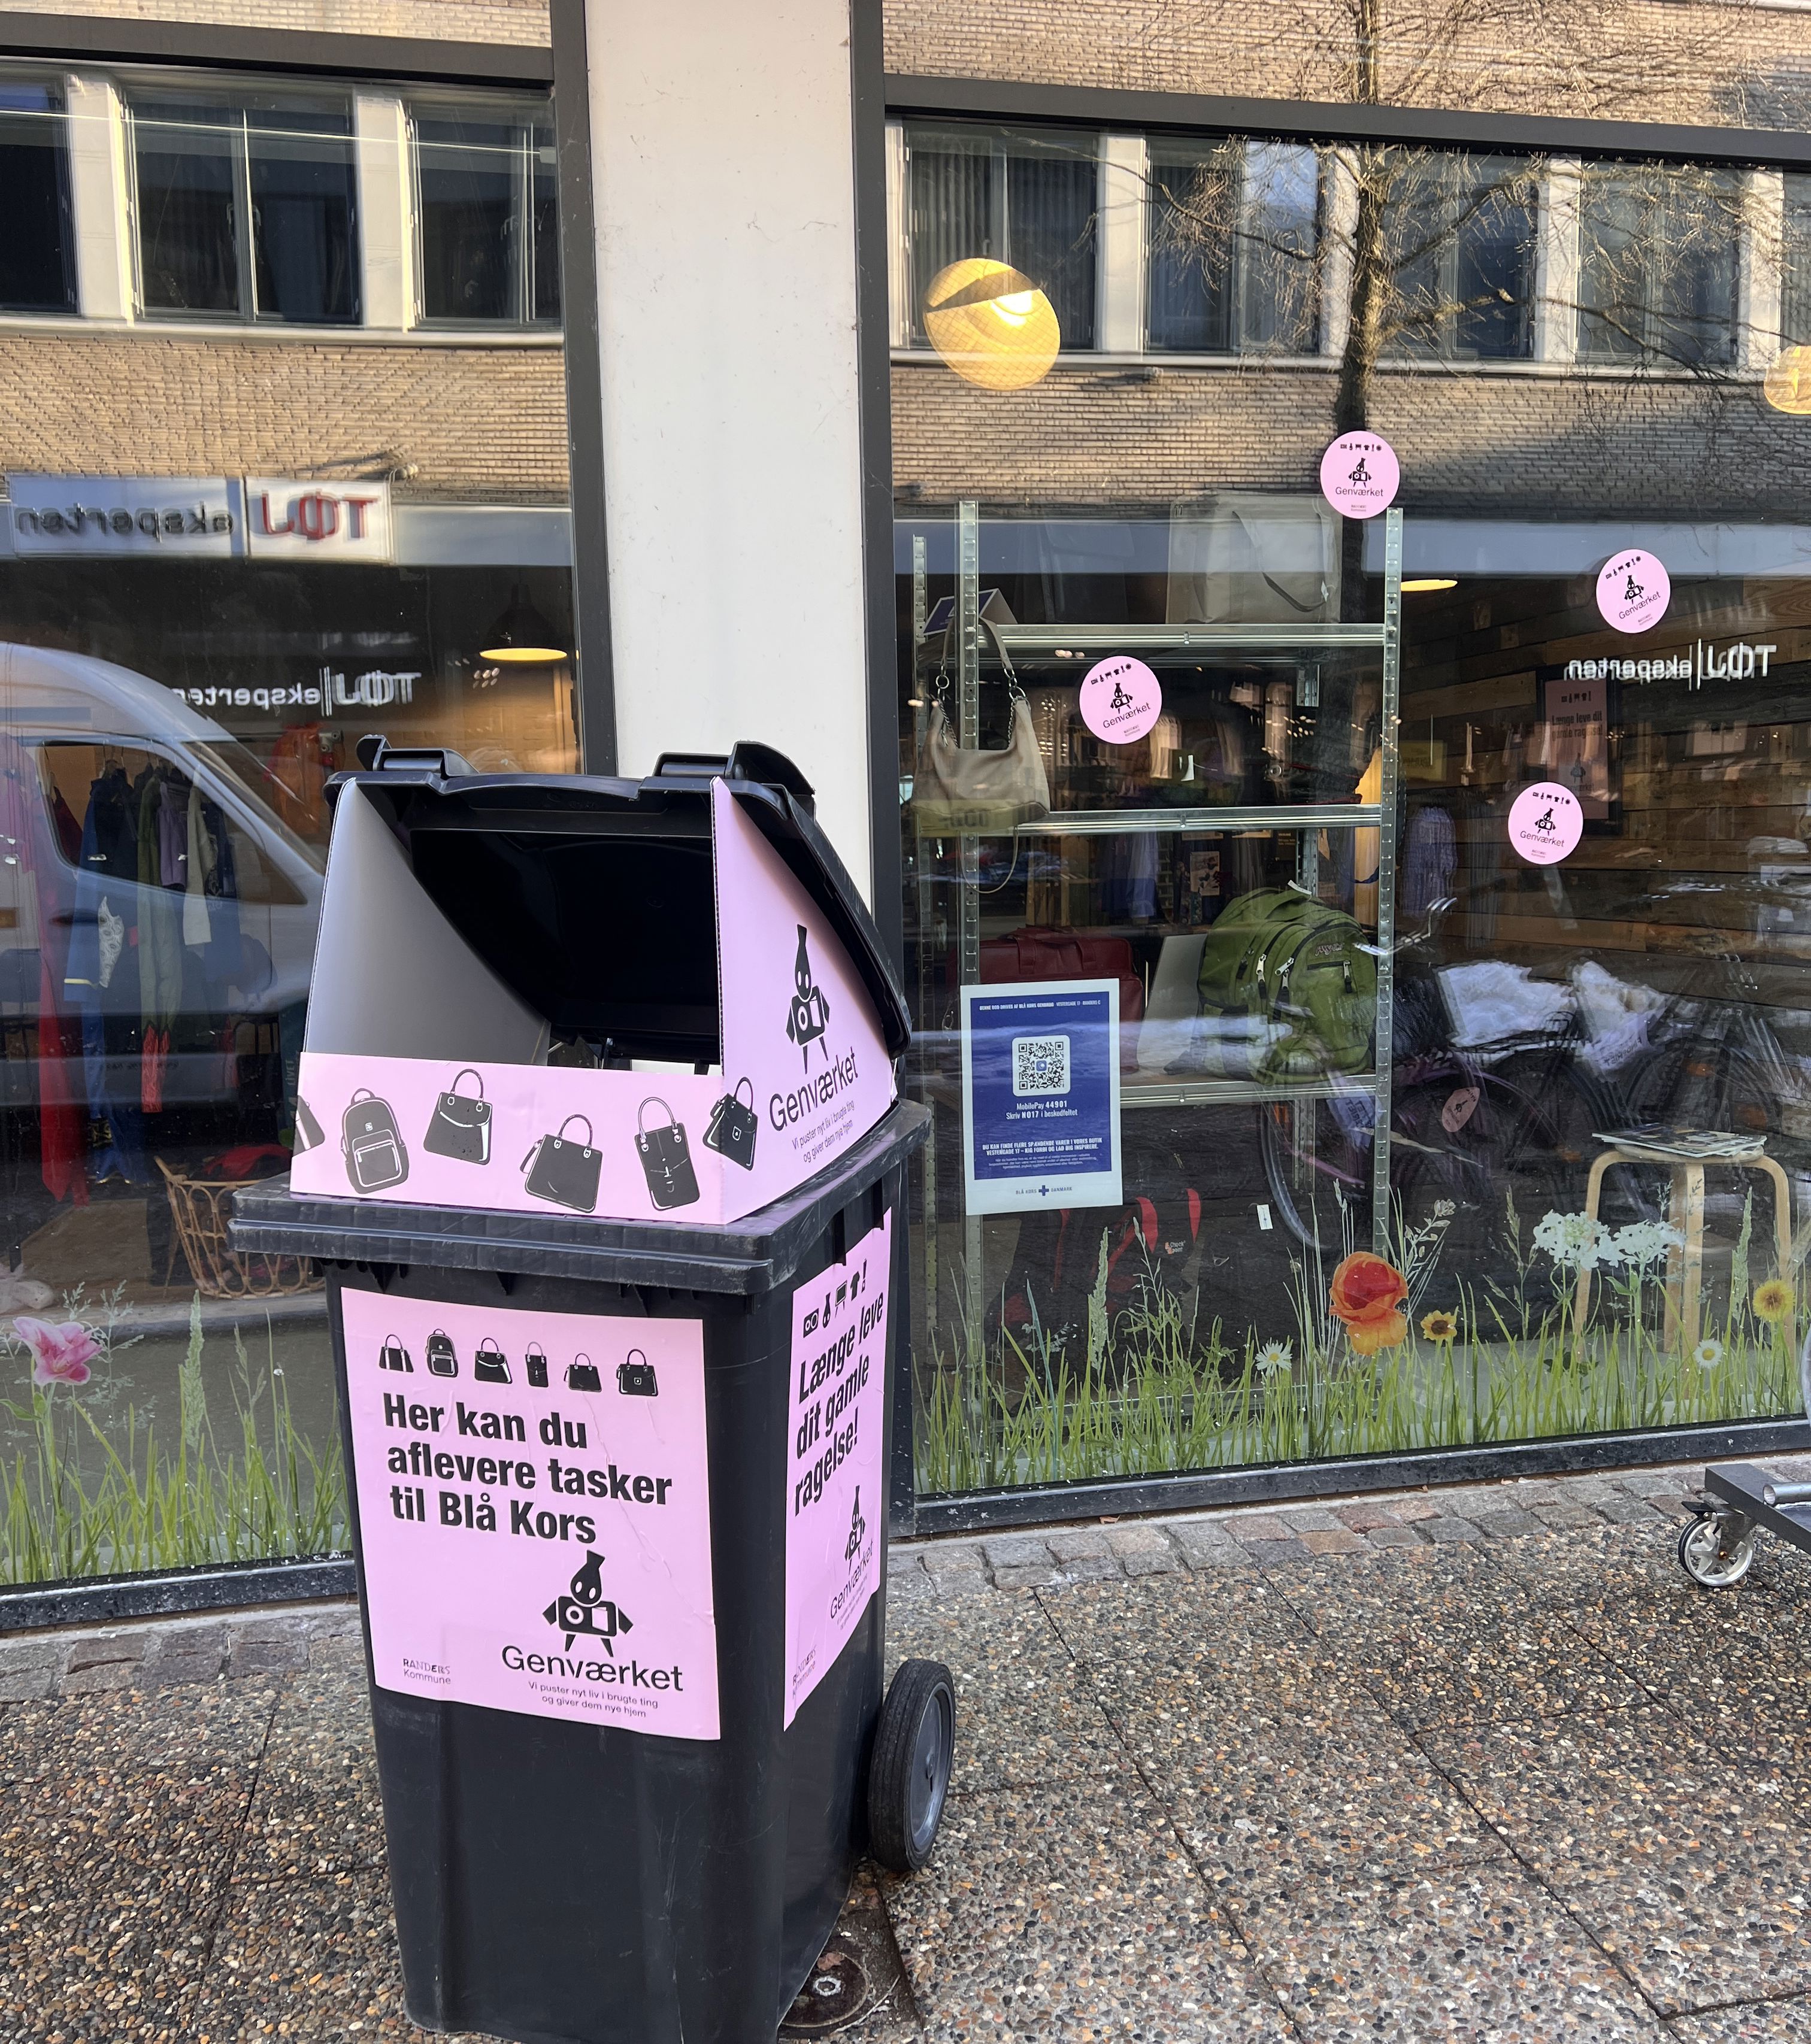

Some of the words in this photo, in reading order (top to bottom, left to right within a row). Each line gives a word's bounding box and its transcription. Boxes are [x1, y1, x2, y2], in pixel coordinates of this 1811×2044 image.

[1335, 487, 1383, 496] Genværket
[1619, 591, 1661, 619] Genværket
[1103, 702, 1150, 728] Genværket
[1520, 830, 1564, 847] Genværket
[770, 1046, 858, 1131] Genværket
[792, 1137, 799, 1150] Vi
[799, 1127, 817, 1150] puster
[817, 1121, 826, 1136] nyt
[834, 1106, 847, 1123] brugte
[846, 1100, 855, 1113] ting
[1044, 1109, 1078, 1117] beskedfeltet
[803, 1151, 811, 1163] og
[812, 1141, 824, 1159] giver
[825, 1135, 835, 1148] dem
[843, 1120, 853, 1135] hjem
[799, 1324, 855, 1404] Længe
[859, 1291, 884, 1345] leve
[383, 1393, 445, 1433] Her
[456, 1402, 526, 1442] kan
[539, 1411, 587, 1449] du
[796, 1400, 821, 1460] dit
[826, 1354, 870, 1433] gamle
[387, 1442, 536, 1490] aflevere
[548, 1458, 673, 1505] tasker
[795, 1406, 858, 1517] ragelse!
[390, 1485, 425, 1522] til
[439, 1491, 496, 1532] Blå
[510, 1499, 596, 1544] Kors
[831, 1538, 874, 1619] Genværket
[402, 1658, 450, 1675] RANDERS
[404, 1668, 452, 1685] Kommune
[502, 1645, 683, 1691] Genværket
[528, 1681, 537, 1690] Vi
[540, 1683, 570, 1695] puster
[572, 1688, 586, 1698] nyt
[589, 1689, 599, 1699] liv
[607, 1692, 637, 1705] brugte
[640, 1697, 659, 1709] ting
[542, 1696, 554, 1705] og
[556, 1696, 579, 1706] giver
[582, 1700, 602, 1710] dem
[605, 1705, 622, 1714] nye
[624, 1706, 646, 1718] hjem
